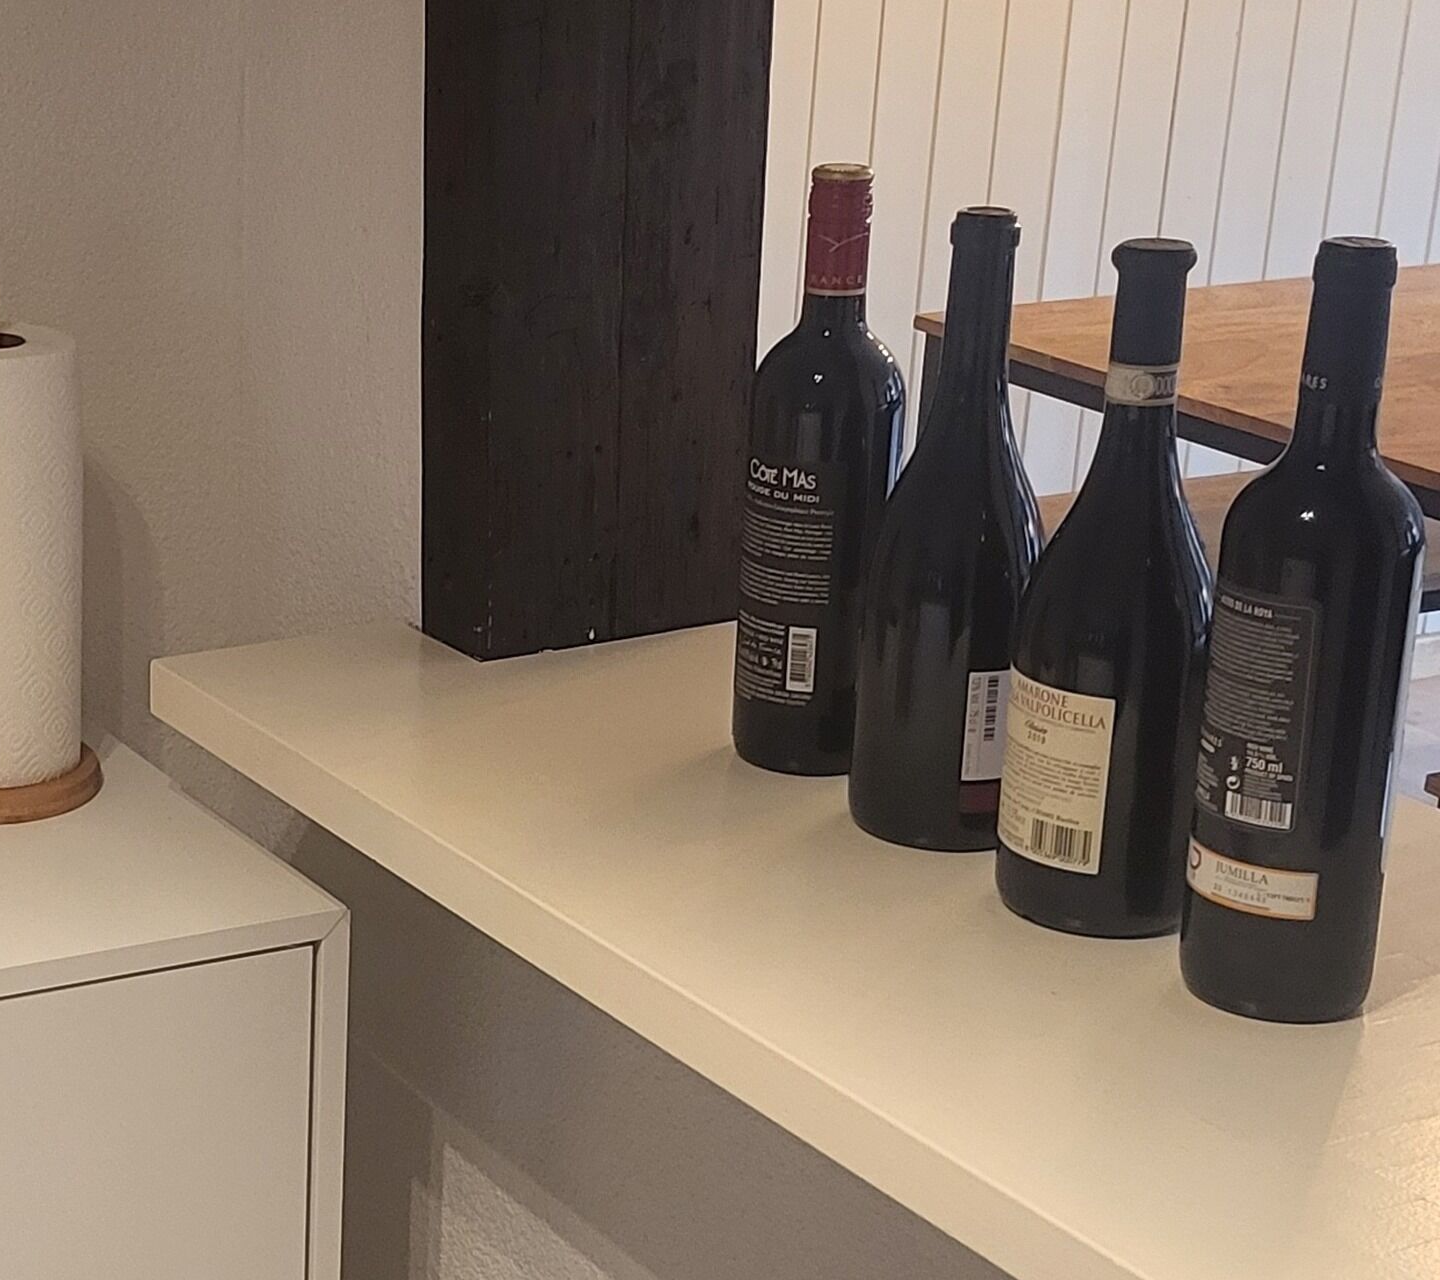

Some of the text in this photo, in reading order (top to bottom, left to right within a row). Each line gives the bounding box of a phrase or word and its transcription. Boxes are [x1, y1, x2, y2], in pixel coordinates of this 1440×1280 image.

[782, 466, 817, 490] MAS
[773, 490, 789, 501] DU
[793, 493, 820, 503] MIDI
[1245, 756, 1284, 774] 750 ml
[1216, 860, 1269, 886] JUMILLA
